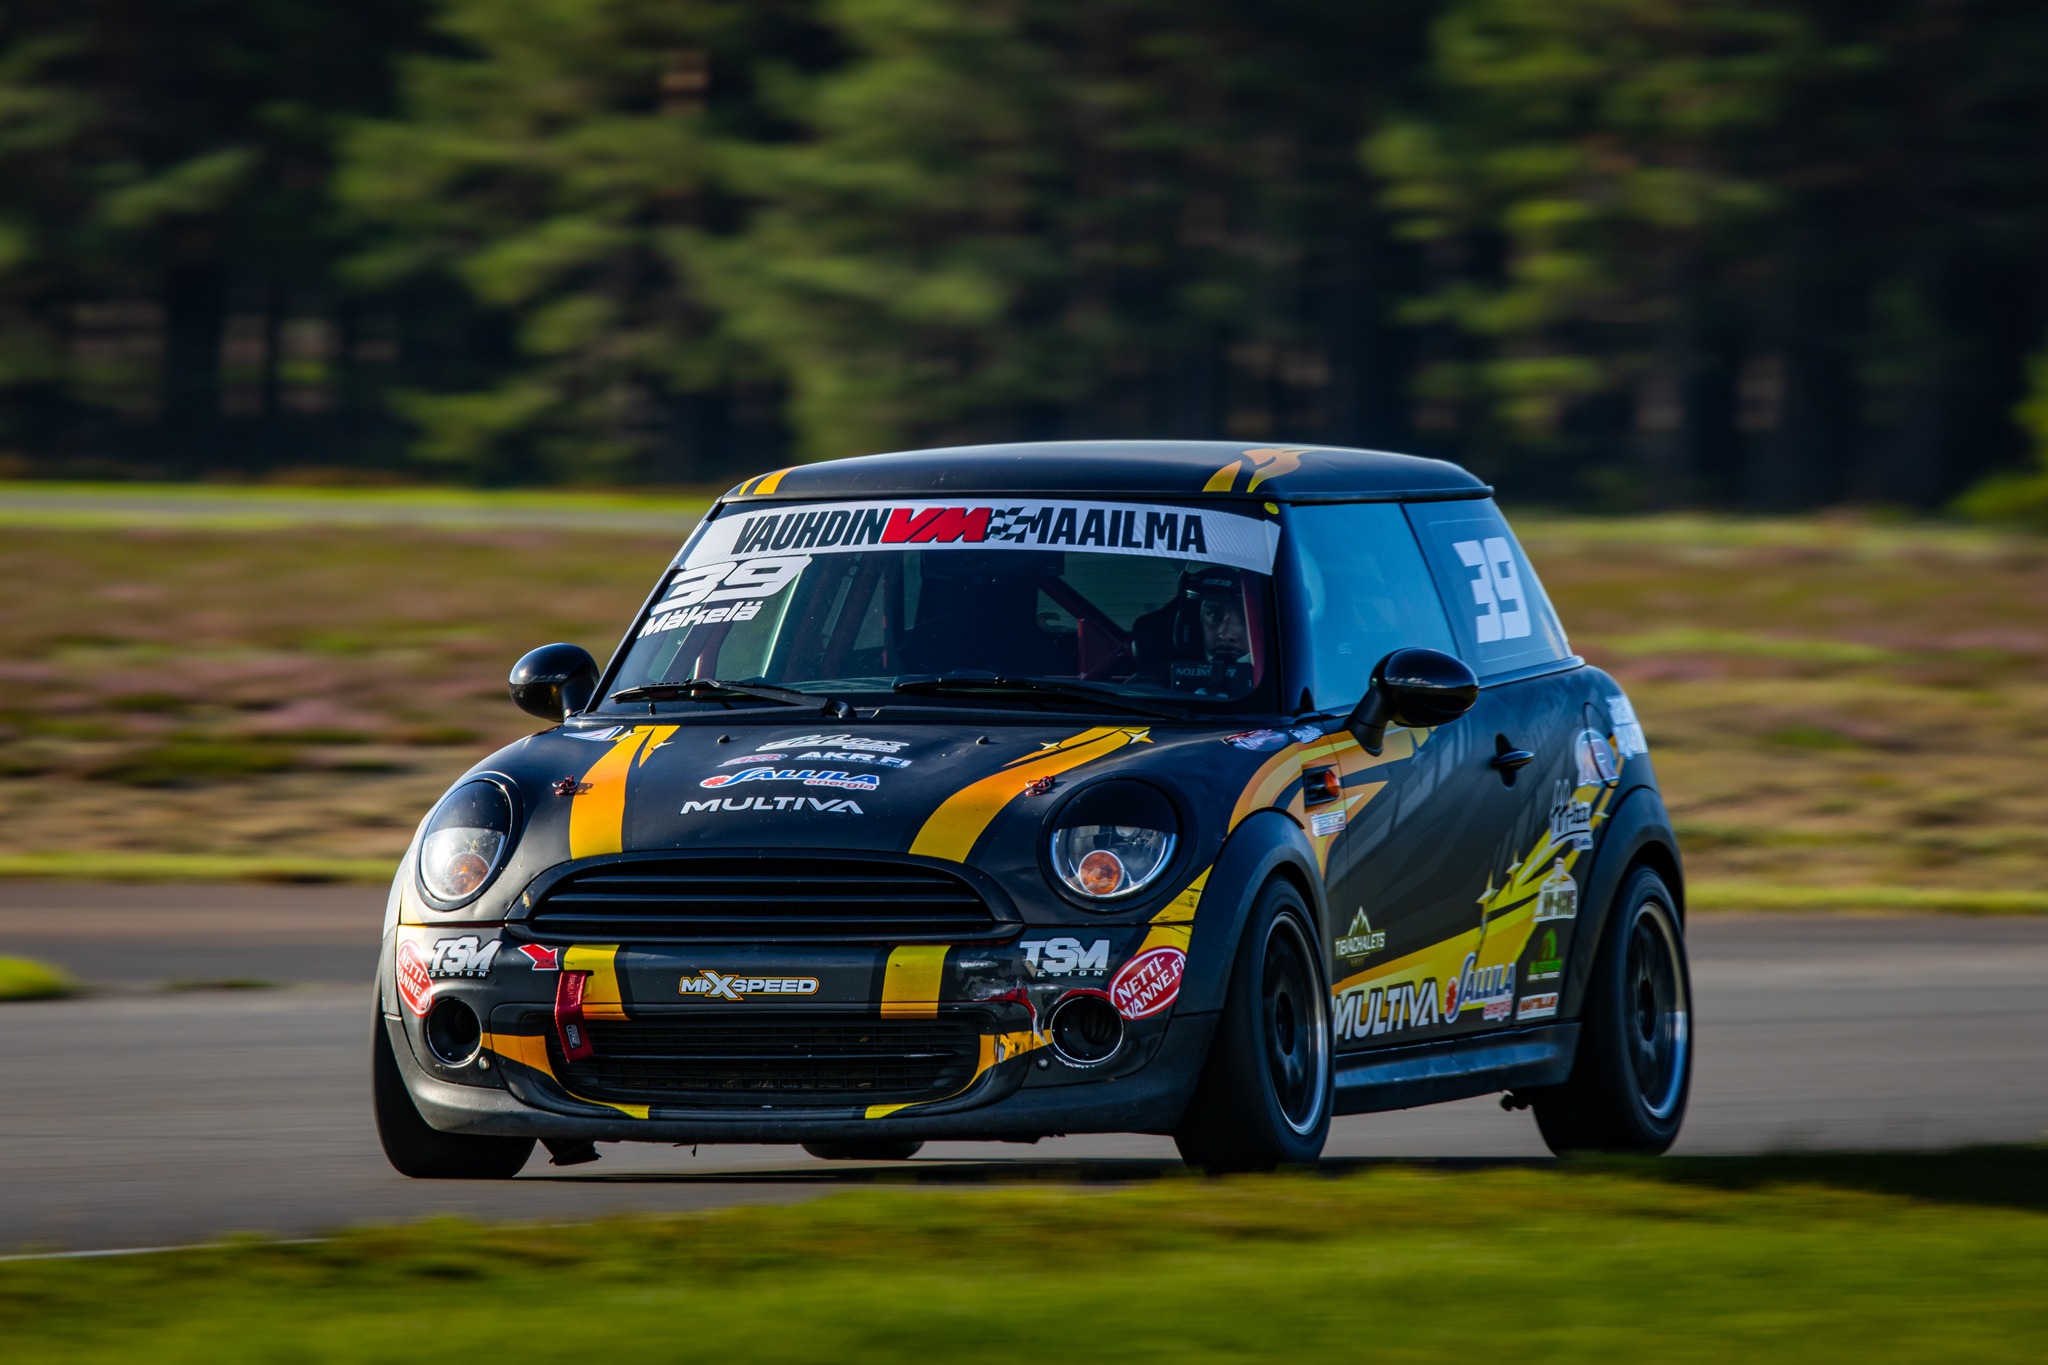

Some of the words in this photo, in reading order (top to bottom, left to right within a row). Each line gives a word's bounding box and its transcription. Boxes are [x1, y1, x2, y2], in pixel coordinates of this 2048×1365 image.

[730, 508, 892, 555] VAUHDIN
[881, 507, 991, 543] VM
[1016, 507, 1207, 554] MAAILMA
[650, 556, 813, 616] 39
[1452, 536, 1532, 644] 39
[637, 601, 764, 639] Mäkelä
[805, 779, 877, 790] energia
[680, 796, 864, 815] MULTIVA
[399, 947, 428, 983] NETTI-
[431, 936, 503, 972] TSM
[1019, 937, 1110, 973] TSM
[1036, 970, 1104, 978] ESIGN
[1116, 956, 1165, 1005] NETTI-
[1124, 954, 1186, 1019] VANNE.FI
[1333, 981, 1439, 1040] MULTIVA
